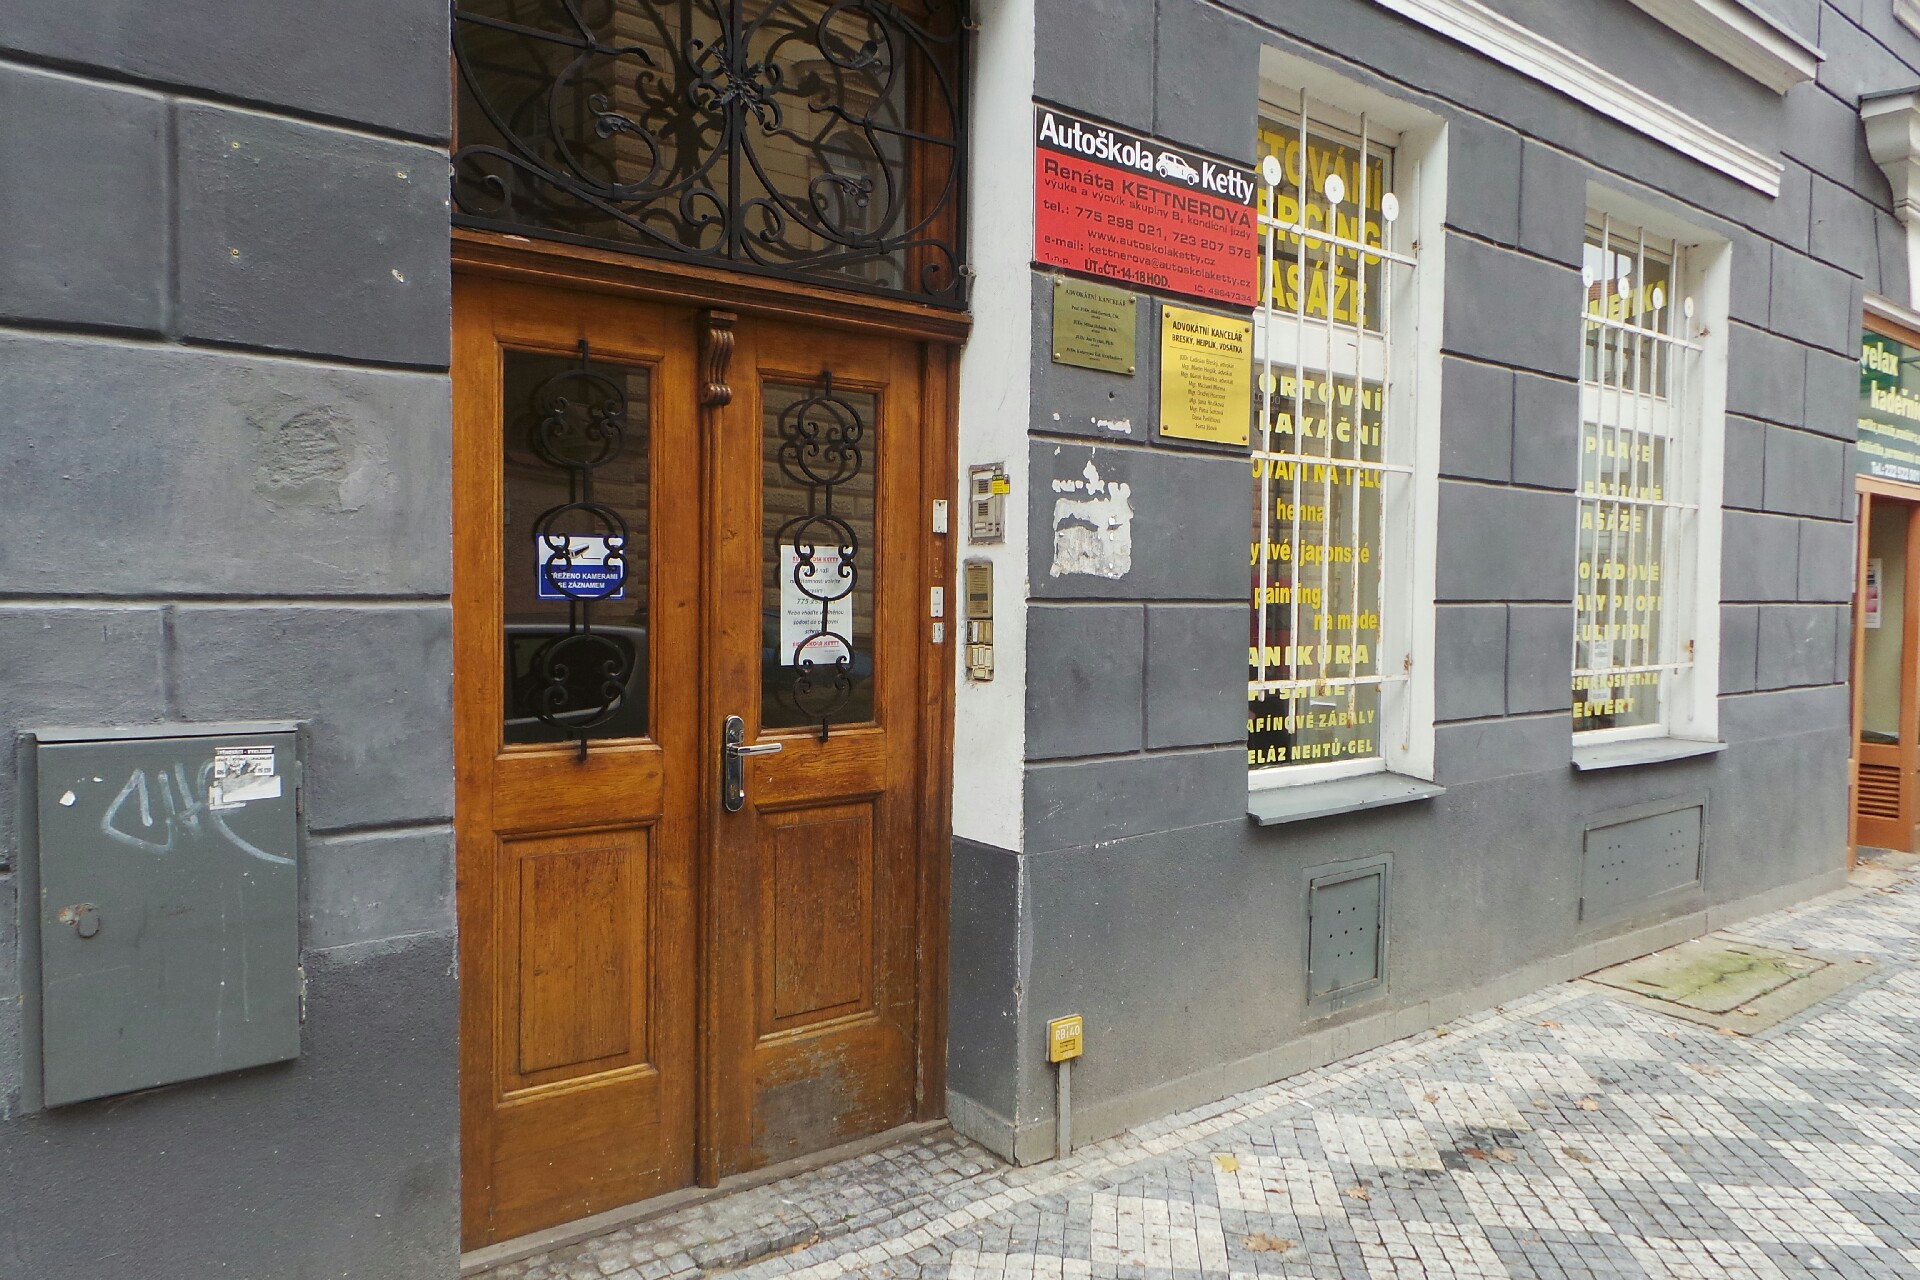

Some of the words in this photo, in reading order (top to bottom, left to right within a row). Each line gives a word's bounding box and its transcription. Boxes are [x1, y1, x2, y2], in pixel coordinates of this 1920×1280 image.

[1039, 113, 1153, 172] Autoškola
[1202, 161, 1254, 205] Ketty
[1044, 157, 1114, 191] Renáta
[1122, 179, 1251, 229] KETTNEROVÁ
[1044, 178, 1077, 193] výuka
[1081, 188, 1088, 196] a
[1092, 190, 1125, 206] výcvik
[1129, 200, 1168, 218] skupiny
[1043, 199, 1069, 214] tel.:
[1075, 206, 1102, 222] 775
[1107, 214, 1134, 230] 298
[1172, 231, 1197, 246] 723
[1200, 239, 1224, 252] 207
[1044, 235, 1084, 250] e-mail:
[1088, 243, 1251, 287] kettnerova@autoskolaketty.cz
[1087, 229, 1216, 265] www.autoskolaketty.cz
[1172, 321, 1210, 335] ADVOKÁTNÍ
[1211, 327, 1243, 342] KANCELÁŘ
[1861, 341, 1899, 377] relax
[1276, 498, 1325, 522] henna
[1299, 540, 1370, 566] japonsé
[567, 581, 605, 589] ZÁZNAMEM
[1254, 582, 1321, 609] paining
